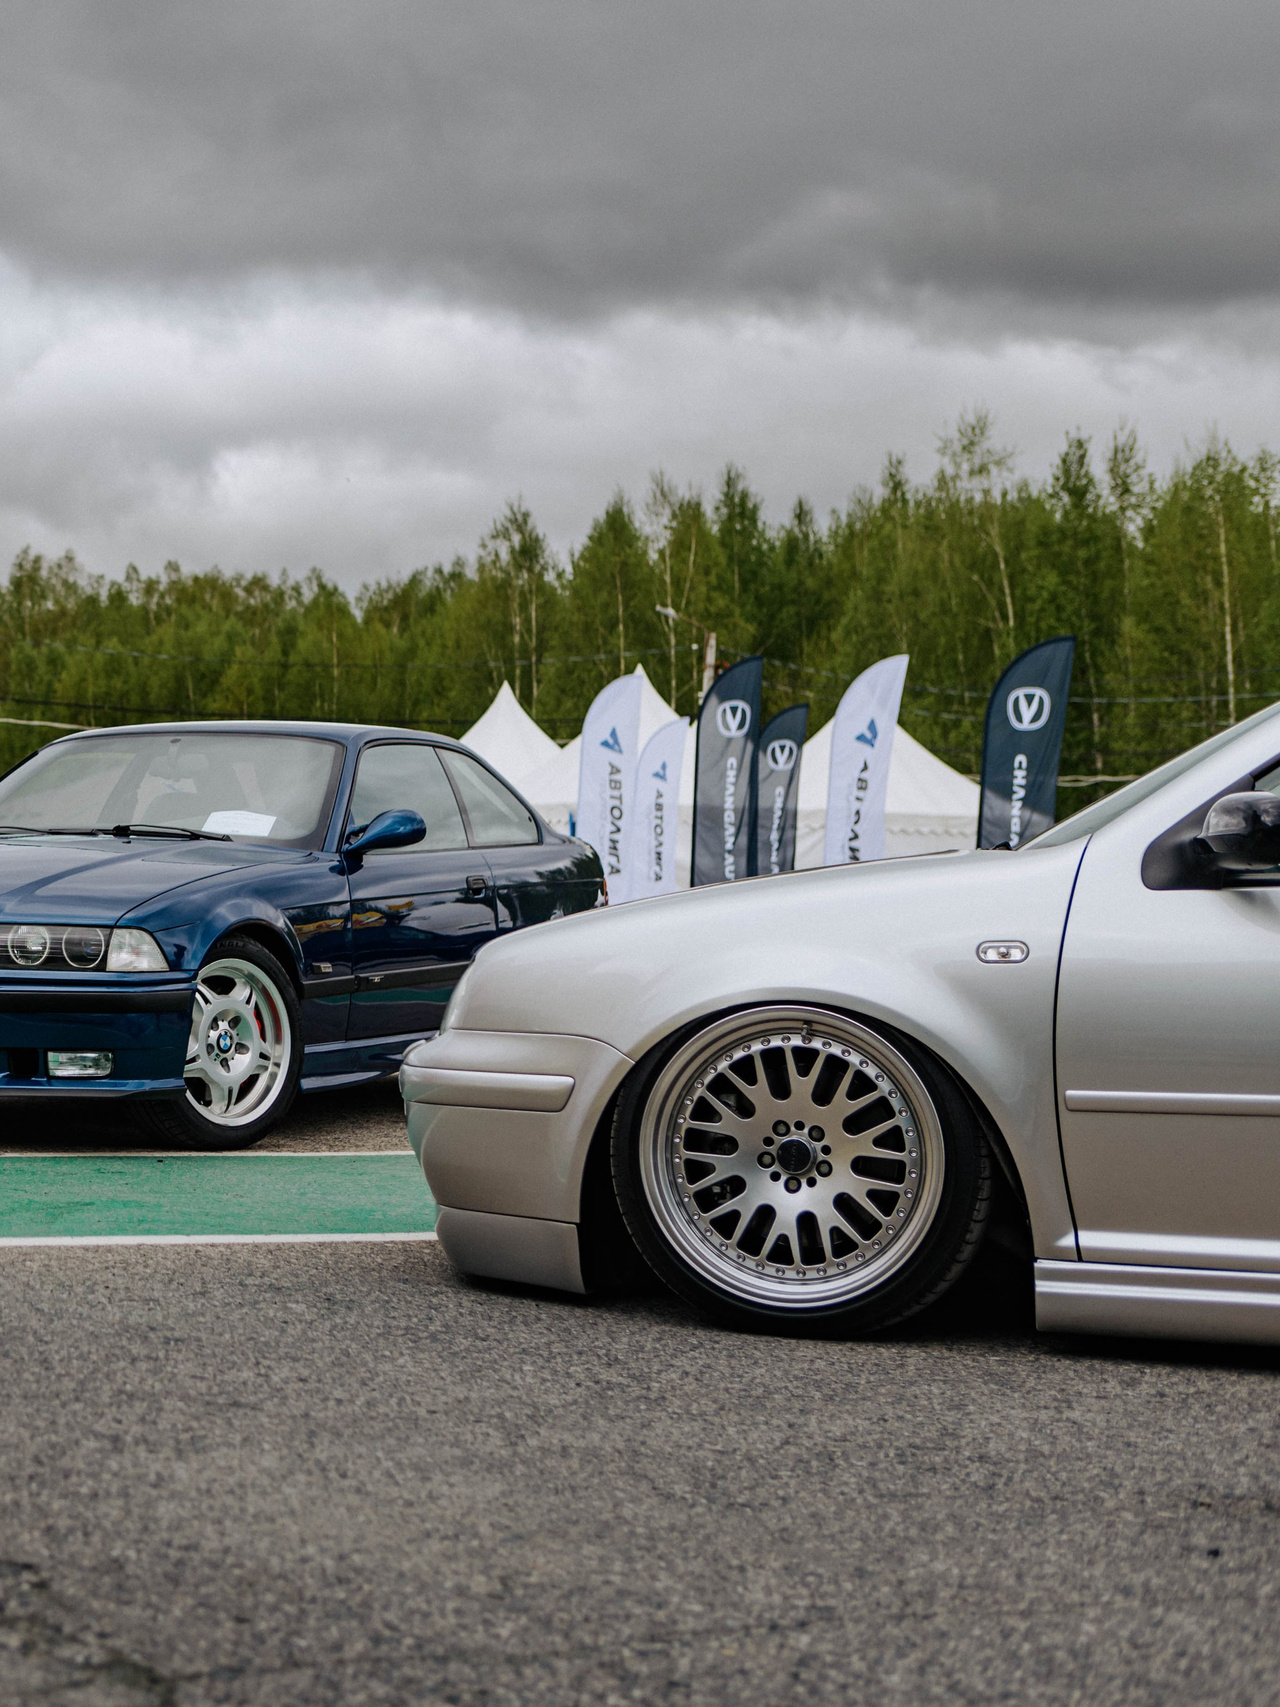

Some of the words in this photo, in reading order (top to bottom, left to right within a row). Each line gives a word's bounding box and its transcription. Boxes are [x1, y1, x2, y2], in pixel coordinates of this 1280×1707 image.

[608, 761, 623, 876] АВТОЛИГА
[653, 788, 664, 882] АВТОЛИГА
[723, 756, 737, 851] CHANGAN
